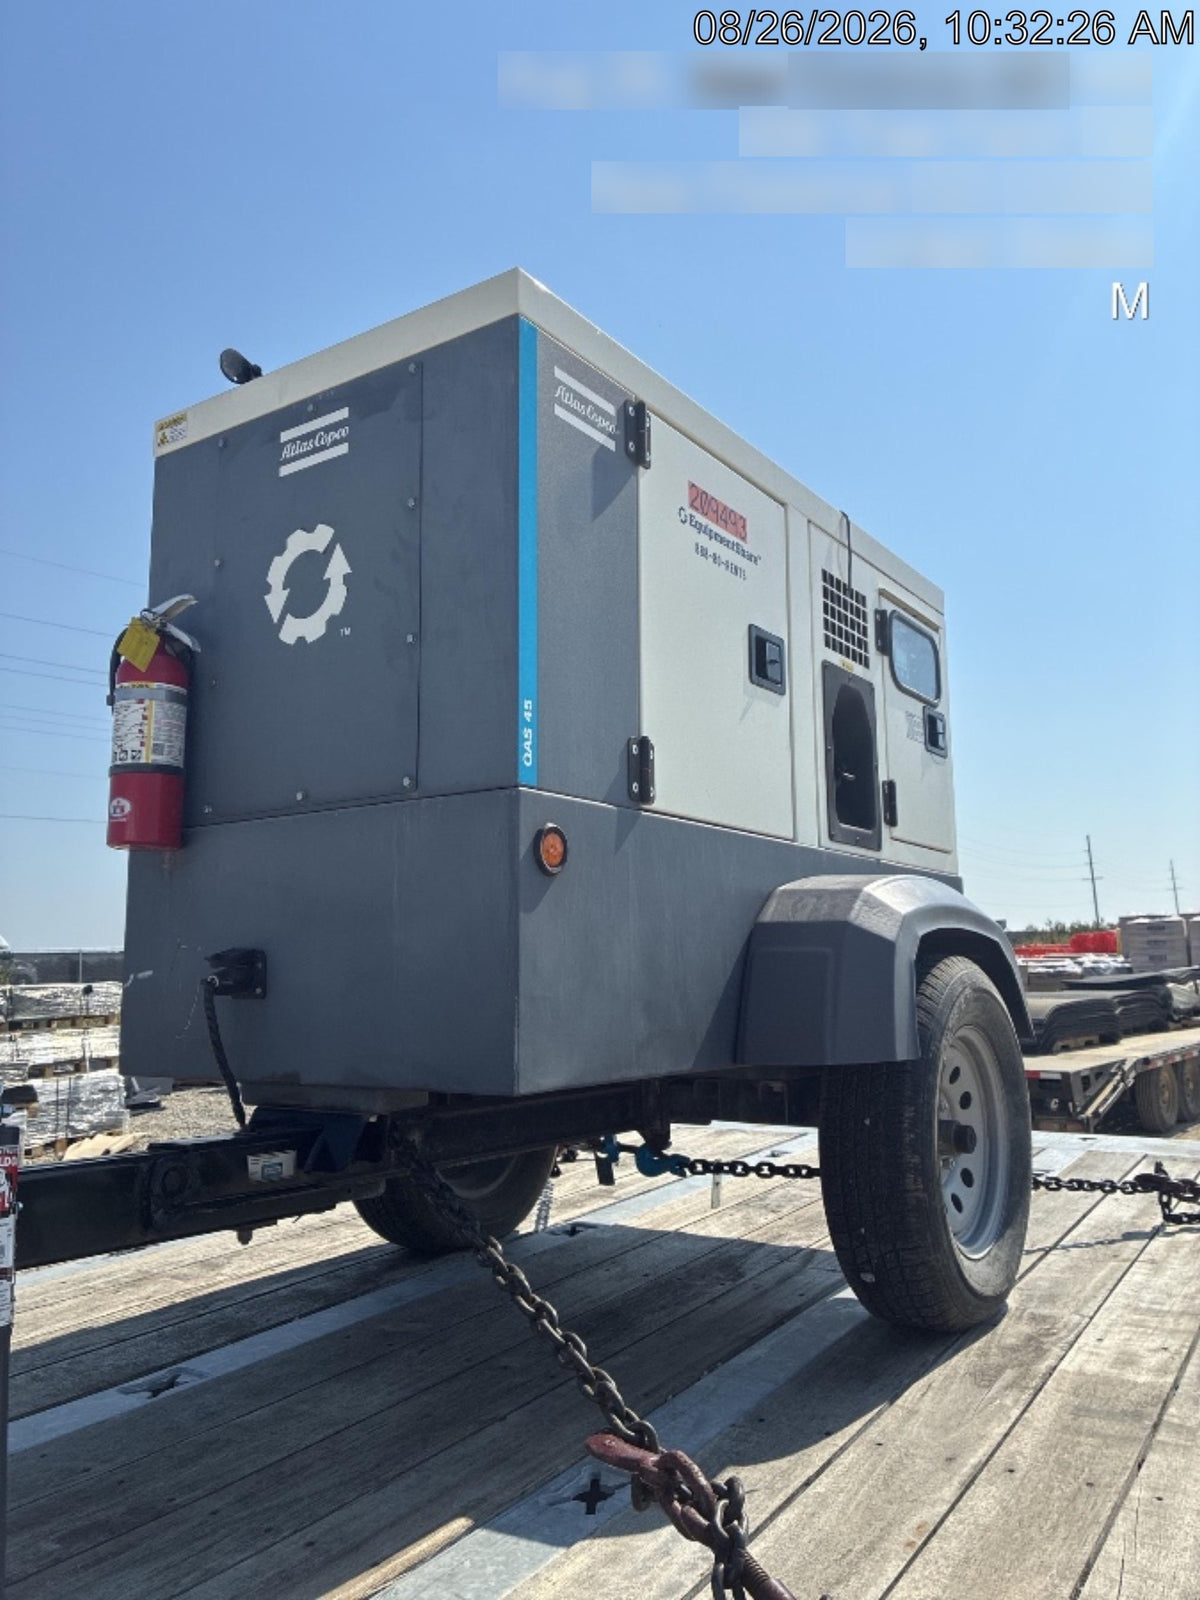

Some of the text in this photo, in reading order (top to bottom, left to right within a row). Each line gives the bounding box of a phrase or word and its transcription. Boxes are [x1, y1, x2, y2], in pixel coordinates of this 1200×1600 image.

[554, 385, 616, 434] Atlas Copco
[280, 425, 349, 461] Atlas Copco
[523, 698, 533, 767] QAS 45
